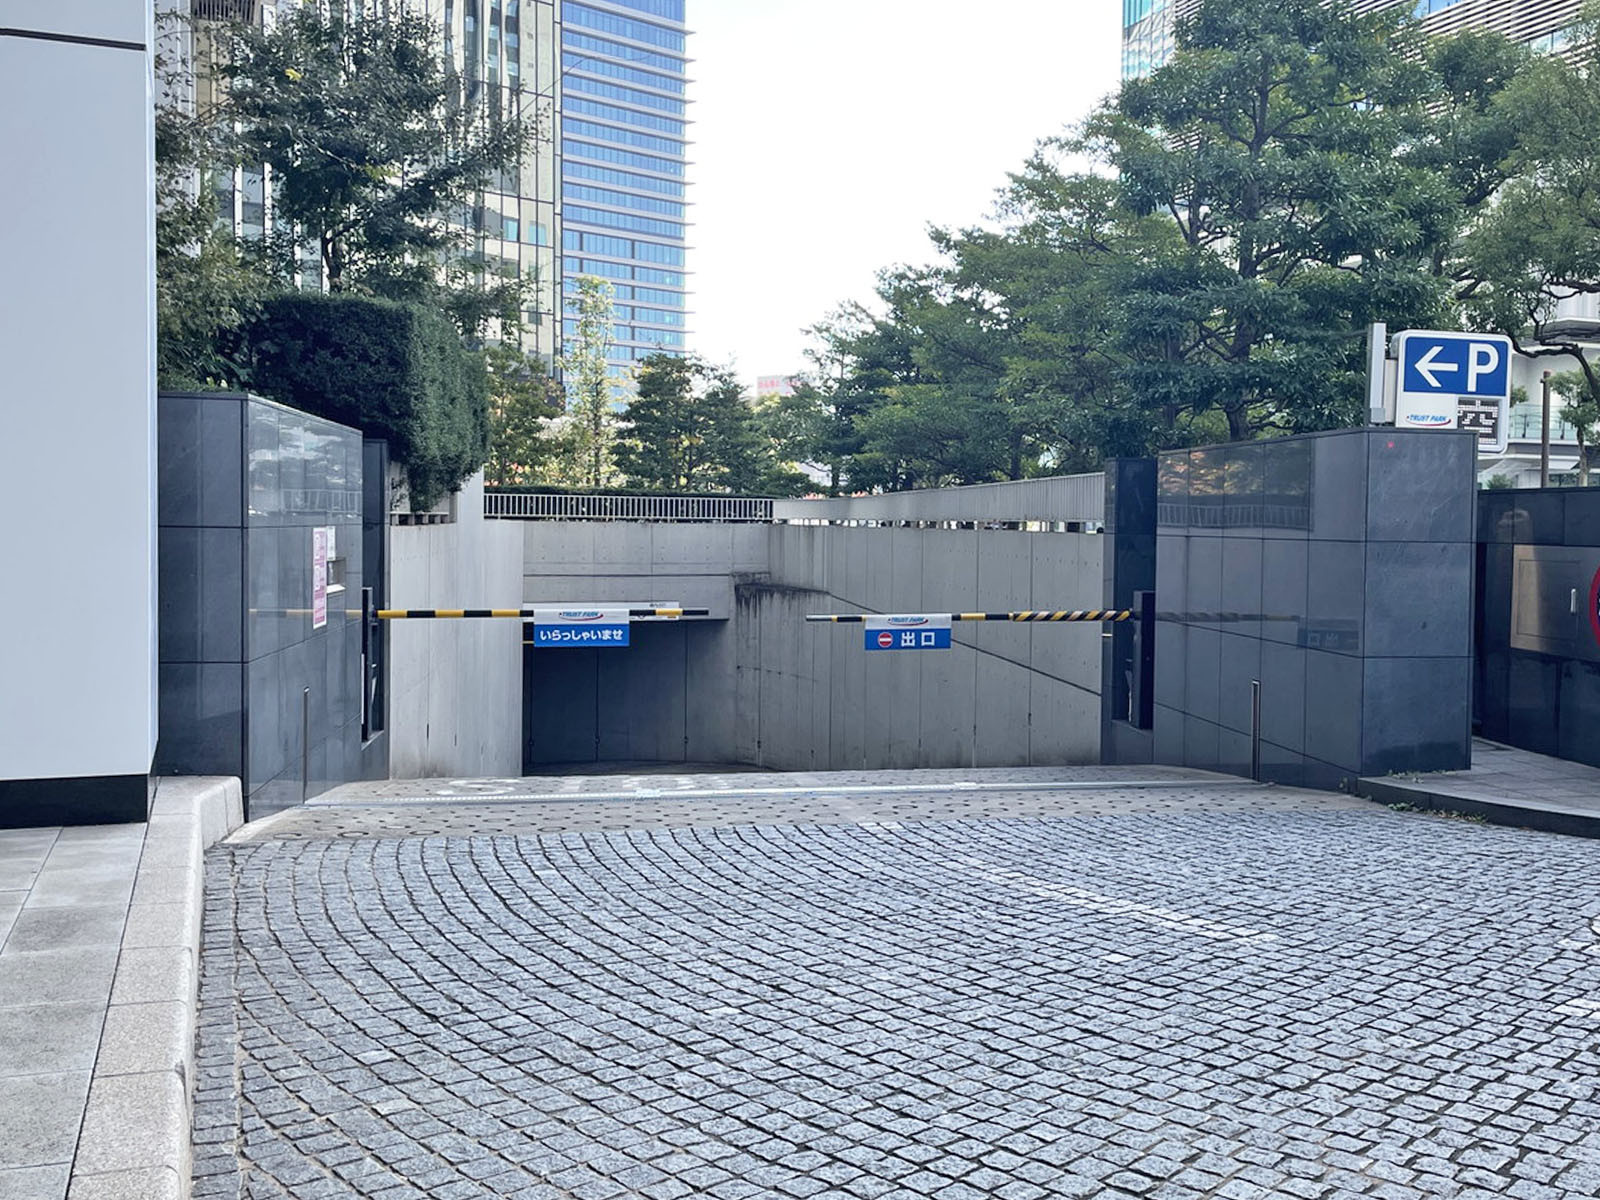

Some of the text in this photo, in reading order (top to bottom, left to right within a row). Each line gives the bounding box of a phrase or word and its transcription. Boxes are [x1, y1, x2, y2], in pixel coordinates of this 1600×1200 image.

[1467, 343, 1499, 392] P
[1457, 399, 1498, 444] 空
[539, 629, 624, 642] いらっしゃいませ
[900, 631, 936, 647] 出口
